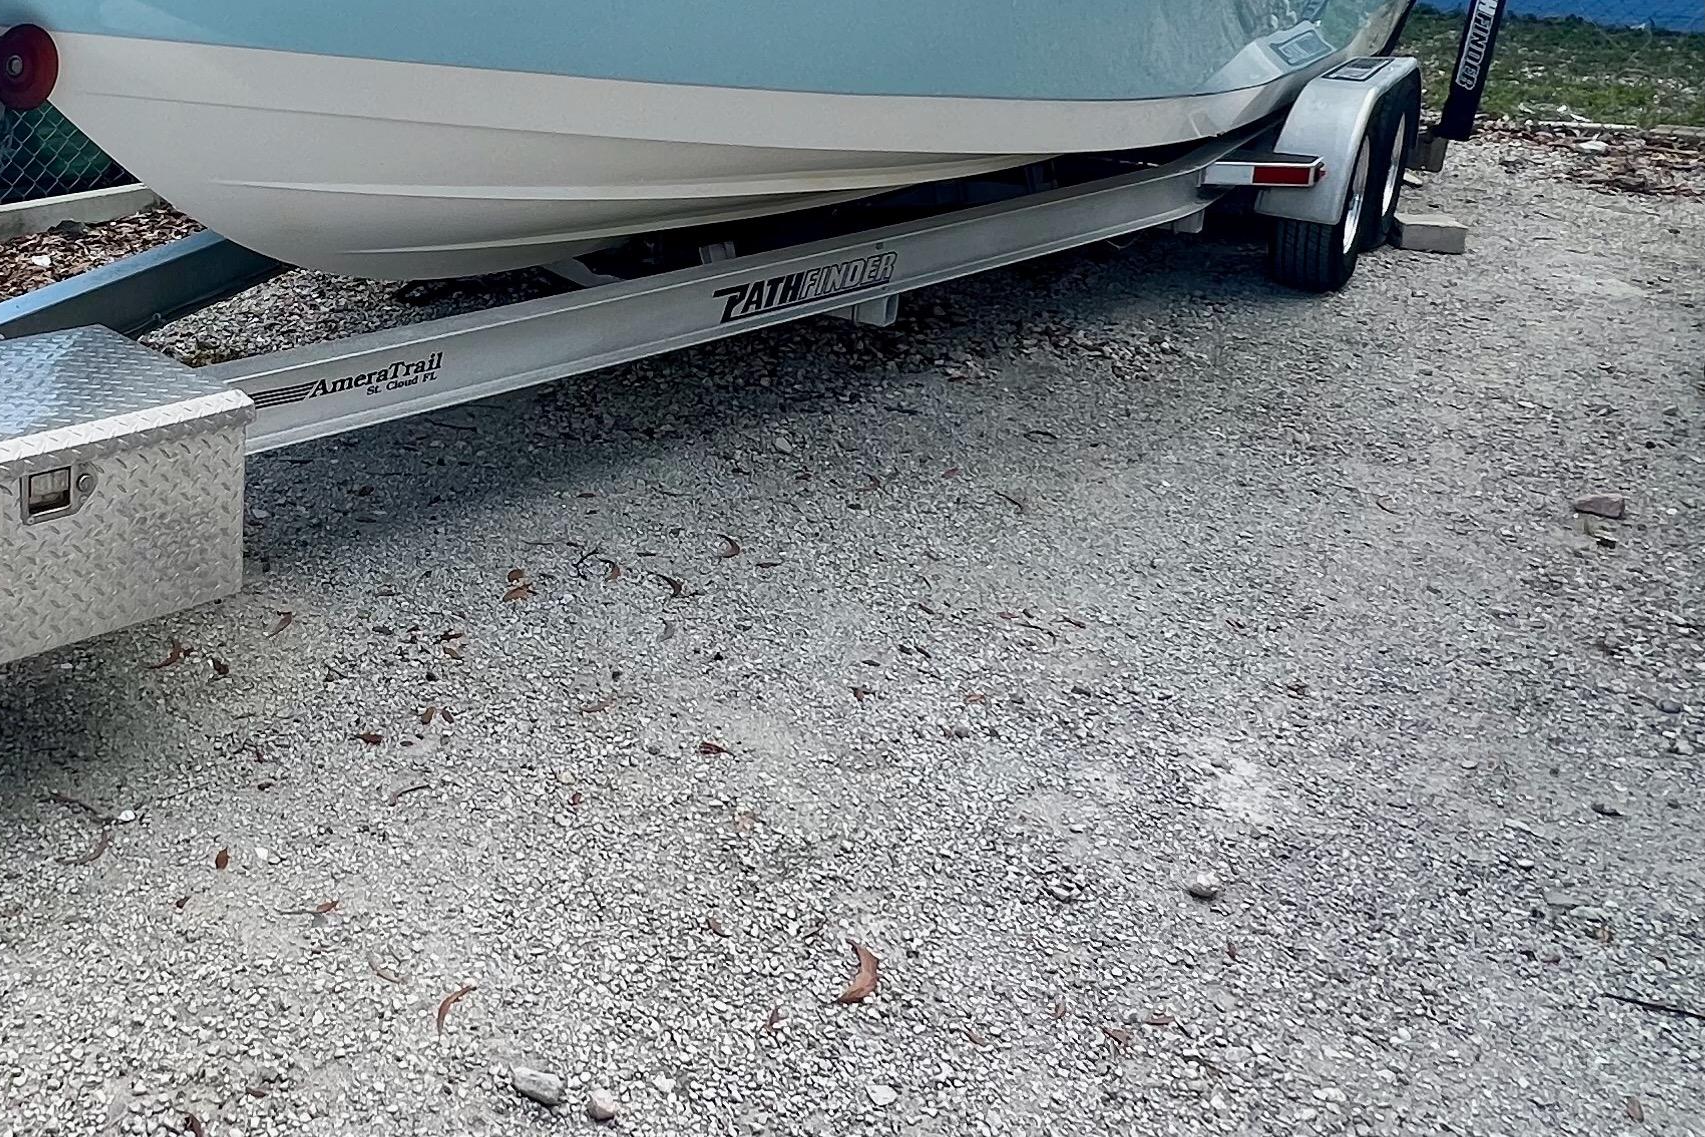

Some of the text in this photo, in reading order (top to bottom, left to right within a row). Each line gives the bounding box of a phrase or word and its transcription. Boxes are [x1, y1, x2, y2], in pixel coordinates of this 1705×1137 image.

[712, 252, 898, 324] PATHFINDER
[308, 351, 444, 399] AmeraTrail
[386, 375, 418, 391] Cloud
[422, 371, 438, 382] FL
